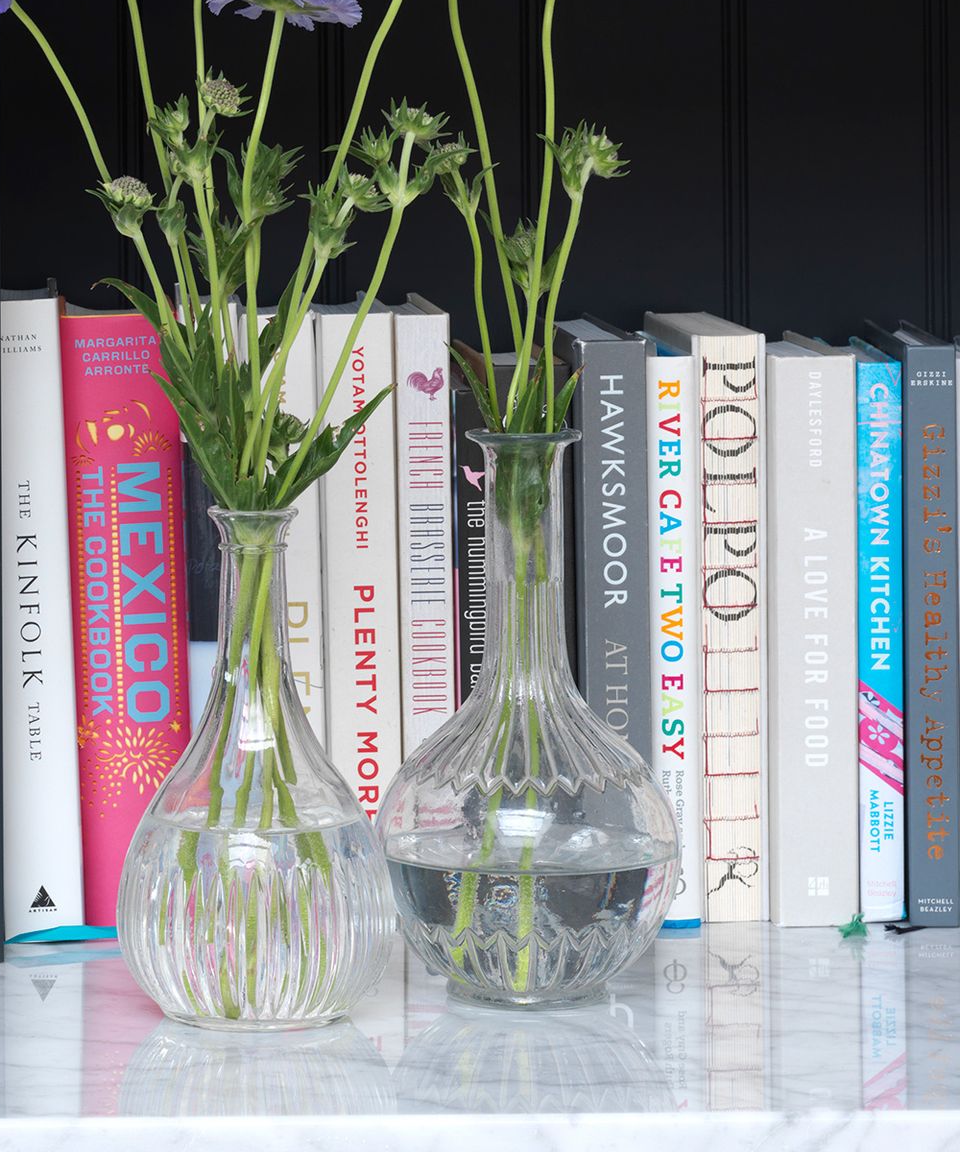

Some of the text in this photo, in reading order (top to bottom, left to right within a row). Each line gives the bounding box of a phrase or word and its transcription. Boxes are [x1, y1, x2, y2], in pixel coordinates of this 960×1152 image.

[2, 346, 42, 354] ILLIAMS
[74, 335, 157, 349] MARGARITA
[82, 350, 150, 363] CARRILLO
[84, 364, 150, 377] ARRONTE
[808, 371, 823, 468] DAYLESFORD
[910, 379, 953, 387] ERSKINE
[81, 466, 114, 716] THE COOKBOOK
[117, 460, 171, 723] MEXICO
[408, 421, 448, 716] FRENCH BRASSERIE COOKBOOK
[599, 374, 628, 609] HAWKSMOOR
[658, 379, 685, 760] RIVER CAFE TWO EASY
[702, 356, 758, 623] POLPO
[869, 383, 891, 671] CHINATOWN KITCHEN
[16, 480, 44, 762] THE KINFOLK TABLE
[353, 584, 379, 823] PLENTY MOR
[604, 639, 628, 676] AT
[804, 527, 830, 767] A LOVE FOR FOOD
[920, 424, 953, 861] Gizzi's Healthy Appetite
[674, 770, 683, 797] Rose
[869, 789, 881, 853] MABBOTT
[883, 801, 894, 841] LIZZIE
